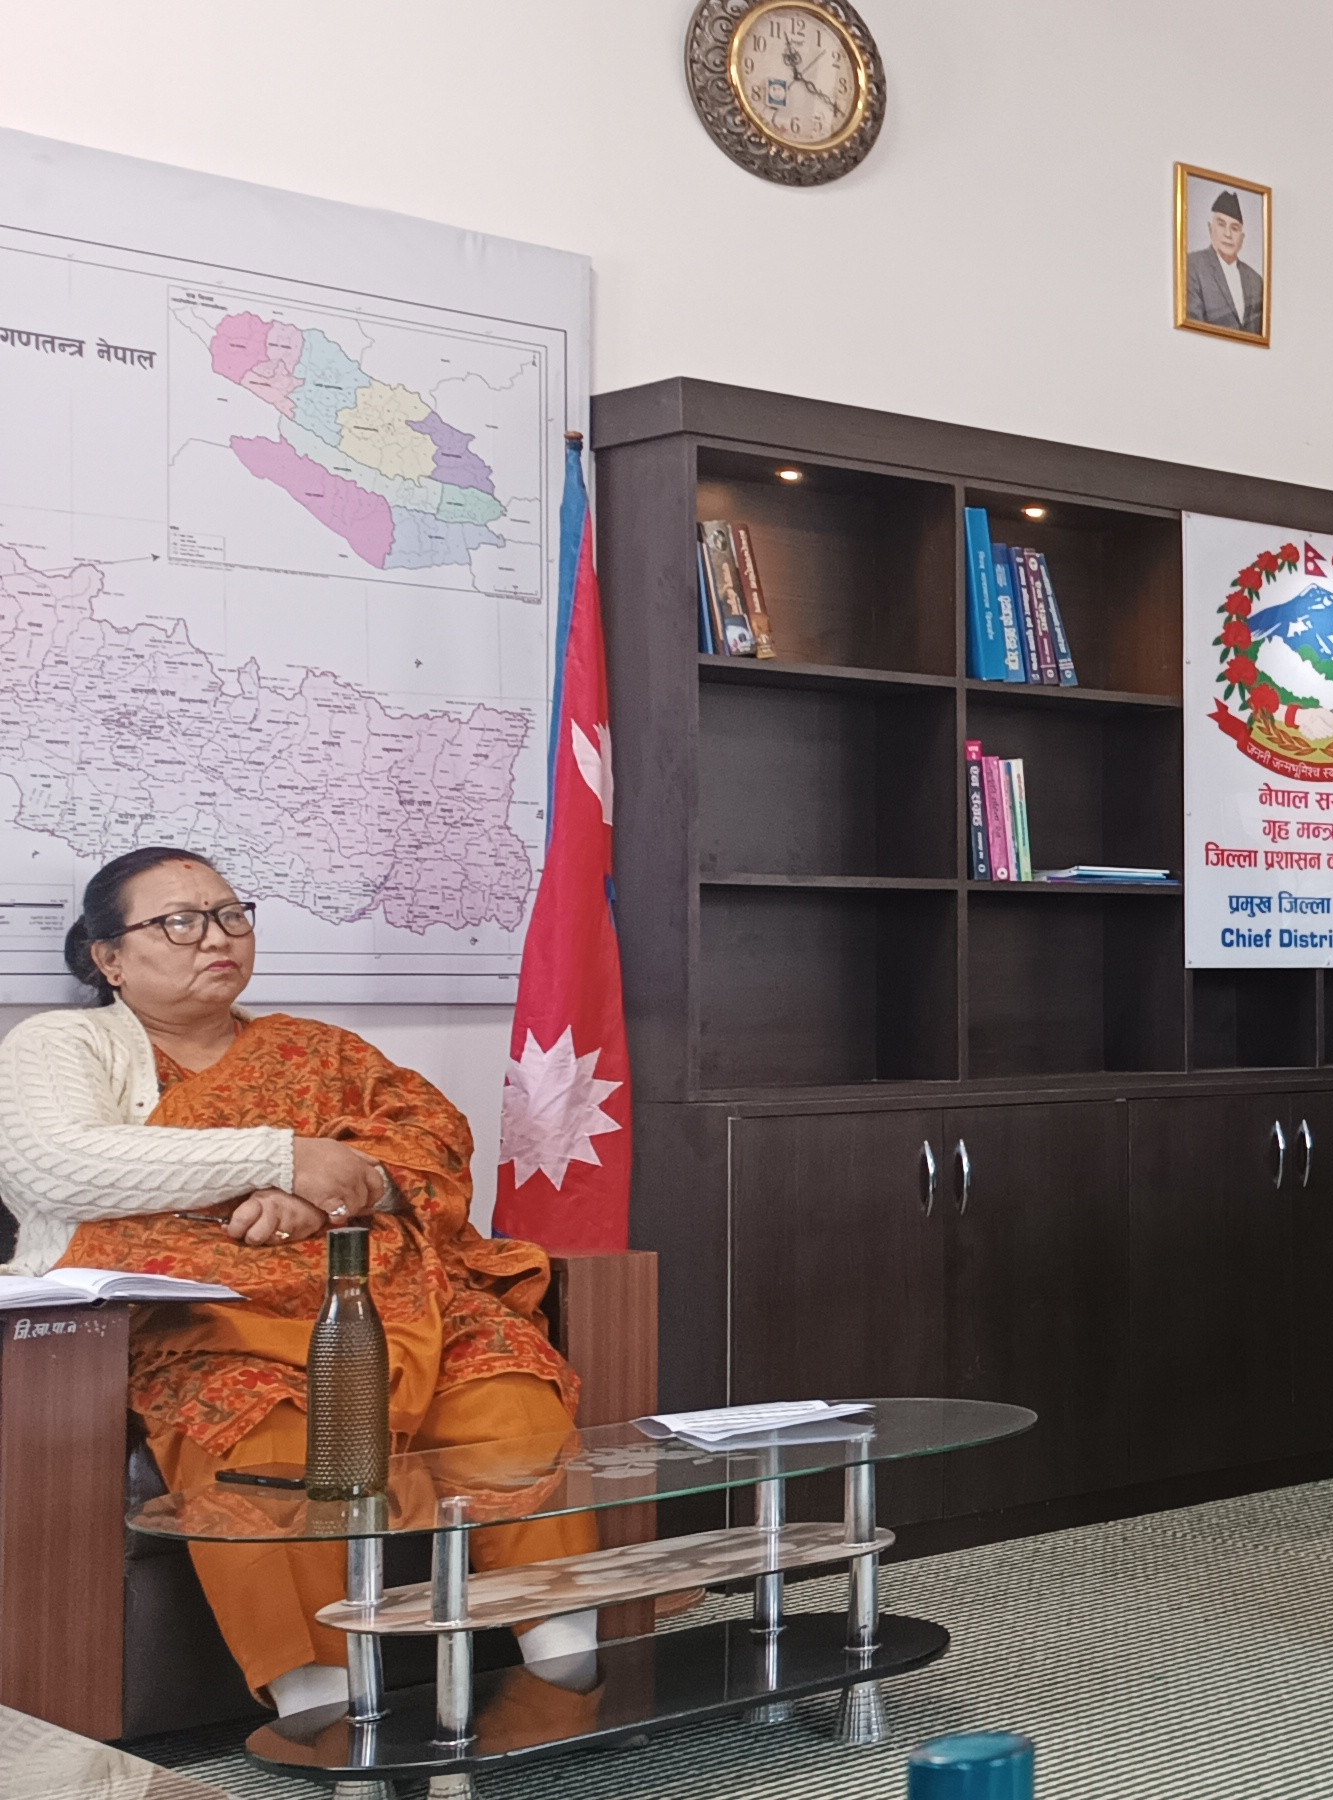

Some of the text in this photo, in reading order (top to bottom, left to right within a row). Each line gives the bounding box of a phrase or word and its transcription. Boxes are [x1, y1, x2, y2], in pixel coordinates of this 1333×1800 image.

[770, 21, 781, 39] 11
[791, 17, 806, 37] 12
[752, 34, 766, 52] 10
[816, 30, 822, 47] 1
[744, 57, 755, 74] 9
[832, 52, 842, 69] 2
[750, 86, 761, 101] 8
[790, 117, 800, 134] 6
[0, 326, 157, 370] गणतन्त्र नेपाल
[1246, 742, 1271, 763] जननी
[969, 767, 980, 787] ऐन
[1258, 784, 1308, 809] नेपाल
[1262, 819, 1290, 843] गृह
[1205, 843, 1257, 868] जिल्ला
[1264, 850, 1321, 870] प्रशासन
[1228, 894, 1272, 918] प्रमुख
[1278, 891, 1330, 915] जिल्ला
[1221, 928, 1272, 948] Chief
